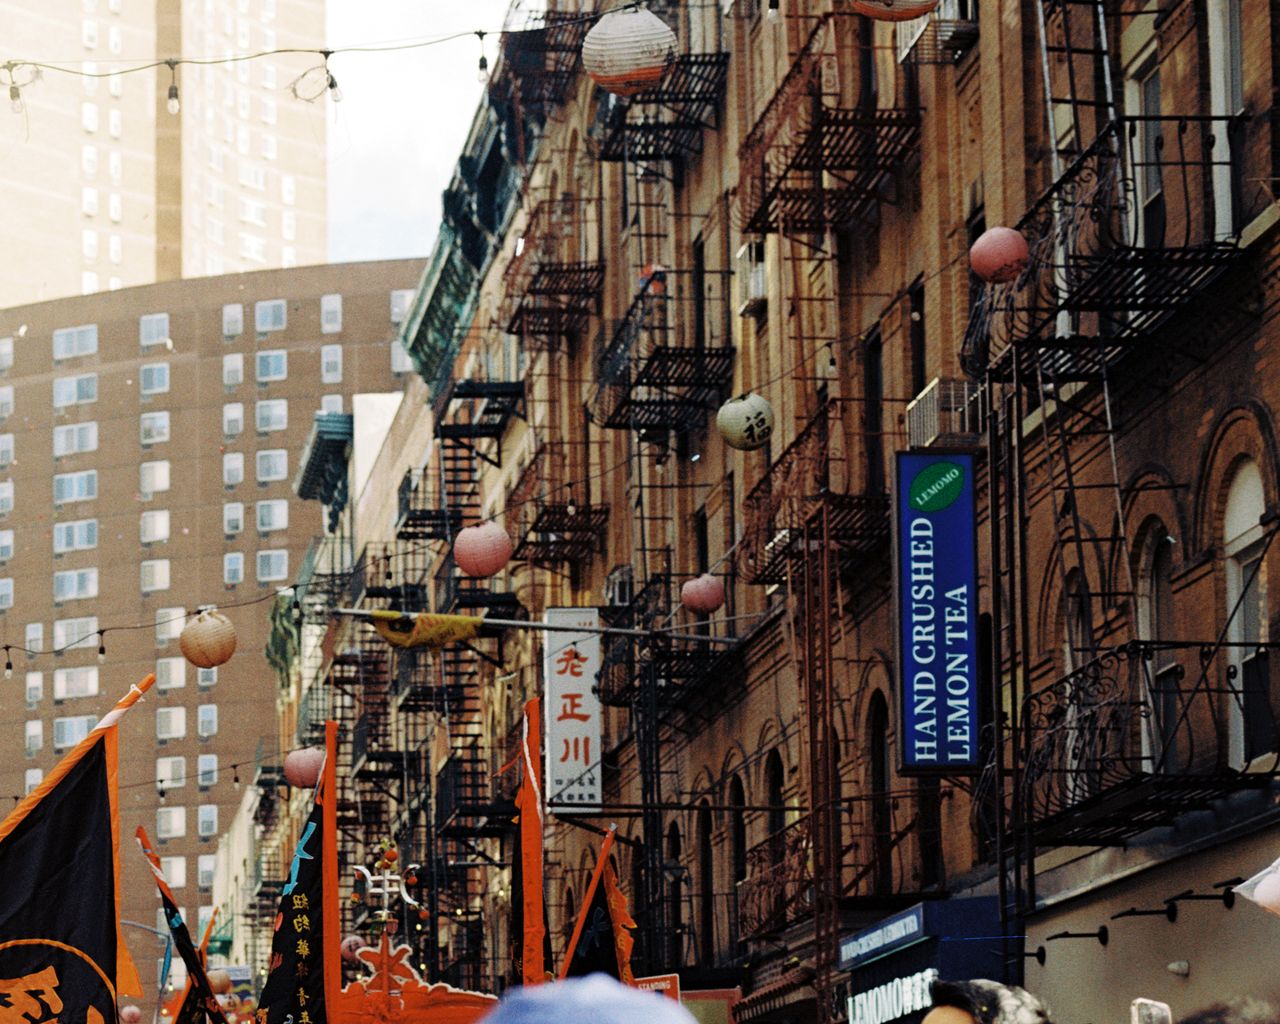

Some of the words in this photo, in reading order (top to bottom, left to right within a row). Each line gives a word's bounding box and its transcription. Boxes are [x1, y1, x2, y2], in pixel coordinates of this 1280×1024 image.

[743, 411, 771, 442] 福
[915, 468, 960, 506] LEMOMO
[910, 516, 936, 665] CRUSHED
[944, 585, 968, 645] TEA
[555, 648, 592, 767] 老正川
[914, 670, 938, 762] HAND
[946, 652, 970, 762] LEMON
